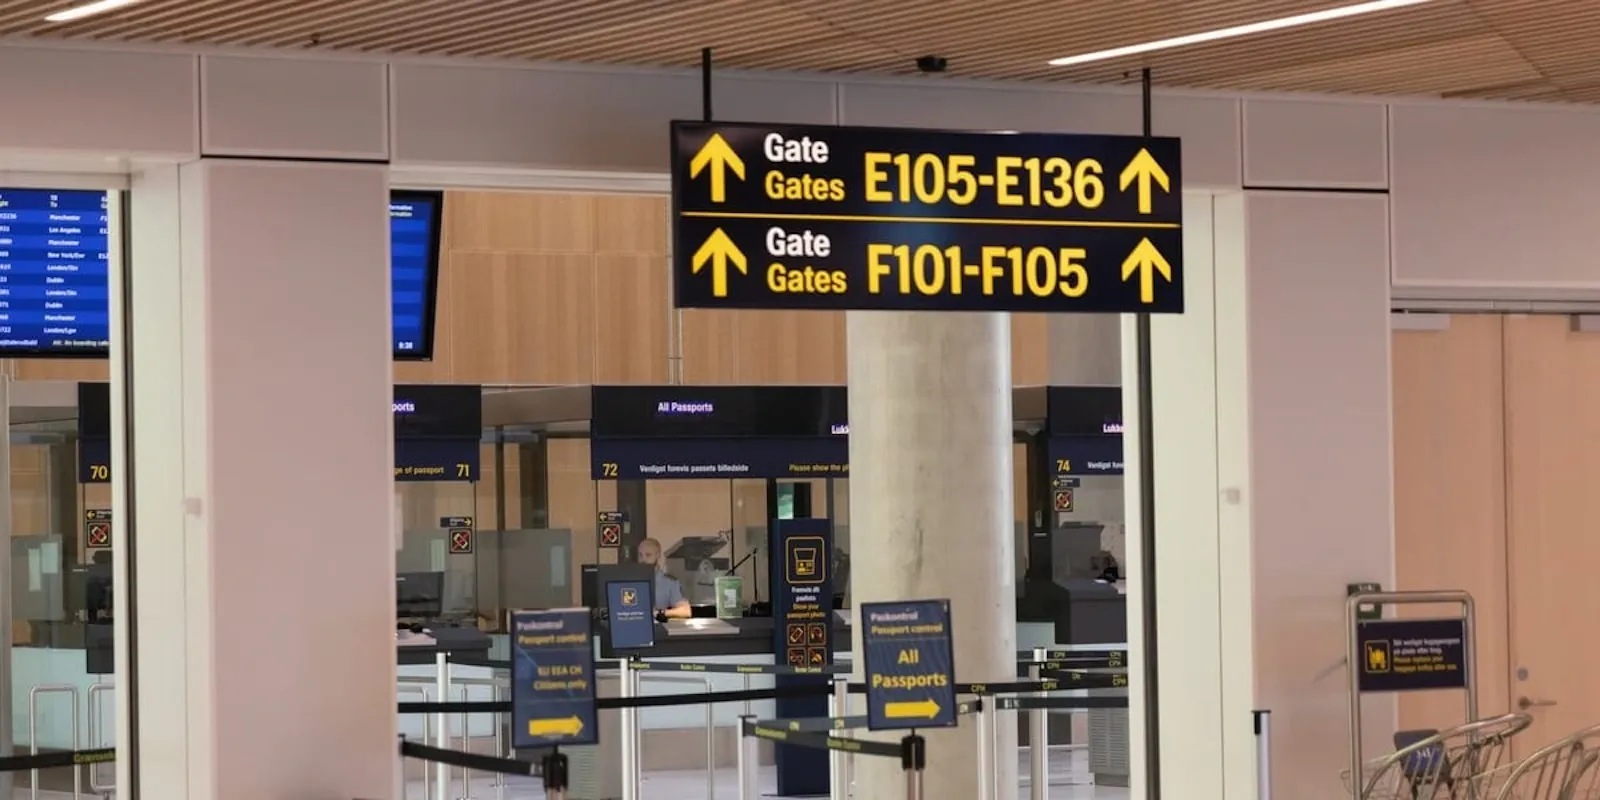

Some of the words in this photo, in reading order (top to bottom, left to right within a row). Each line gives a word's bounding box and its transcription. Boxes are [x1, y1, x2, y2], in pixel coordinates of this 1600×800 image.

[764, 133, 829, 163] Gate
[765, 170, 845, 201] Gates
[865, 151, 1104, 208] E105-E136
[59, 227, 81, 235] Angeles
[765, 226, 831, 257] Gate
[767, 263, 847, 294] Gates
[868, 243, 1088, 298] F101-F105
[657, 402, 669, 412] All
[671, 402, 713, 413] Passports
[90, 465, 108, 480] 70
[404, 466, 413, 474] of
[413, 466, 444, 475] passport
[456, 463, 470, 477] 71
[602, 463, 618, 477] 72
[640, 464, 667, 473] Venligst
[667, 464, 690, 472] forevis
[691, 465, 716, 473] passets
[717, 464, 749, 472] billedside
[789, 464, 811, 472] Please
[830, 464, 841, 472] the
[1056, 459, 1071, 472] 74
[870, 612, 918, 622] Paskontrol
[871, 625, 910, 636] Passport
[911, 622, 943, 633] control
[518, 634, 555, 645] Passport
[555, 633, 587, 643] control
[897, 648, 919, 664] All
[567, 680, 587, 691] only
[872, 673, 948, 690] Passports
